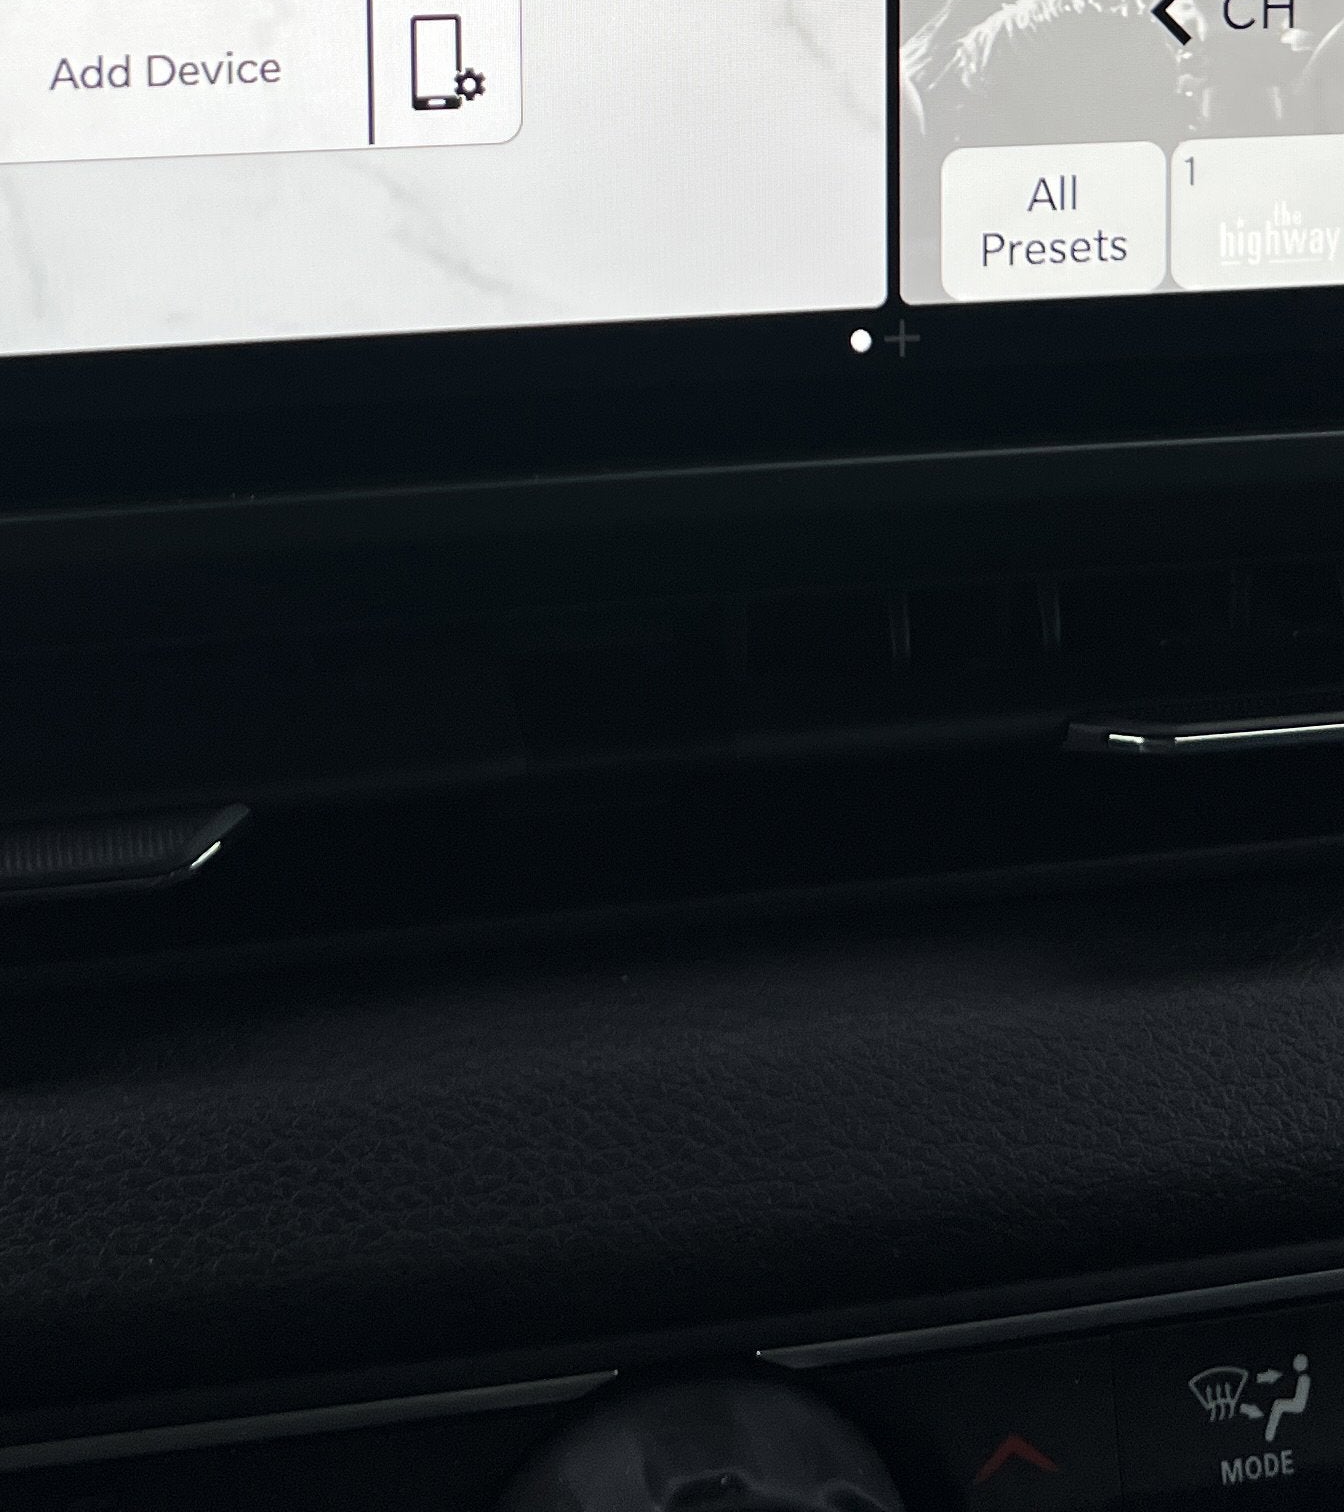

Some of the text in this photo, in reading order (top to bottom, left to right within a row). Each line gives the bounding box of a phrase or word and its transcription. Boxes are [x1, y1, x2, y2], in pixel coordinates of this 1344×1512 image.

[50, 50, 281, 91] Add Device
[1184, 156, 1195, 186] 1
[1027, 175, 1078, 212] All
[1273, 199, 1302, 227] the
[982, 229, 1127, 268] Presets
[1219, 217, 1341, 265] highway
[1220, 1450, 1295, 1485] MODE
